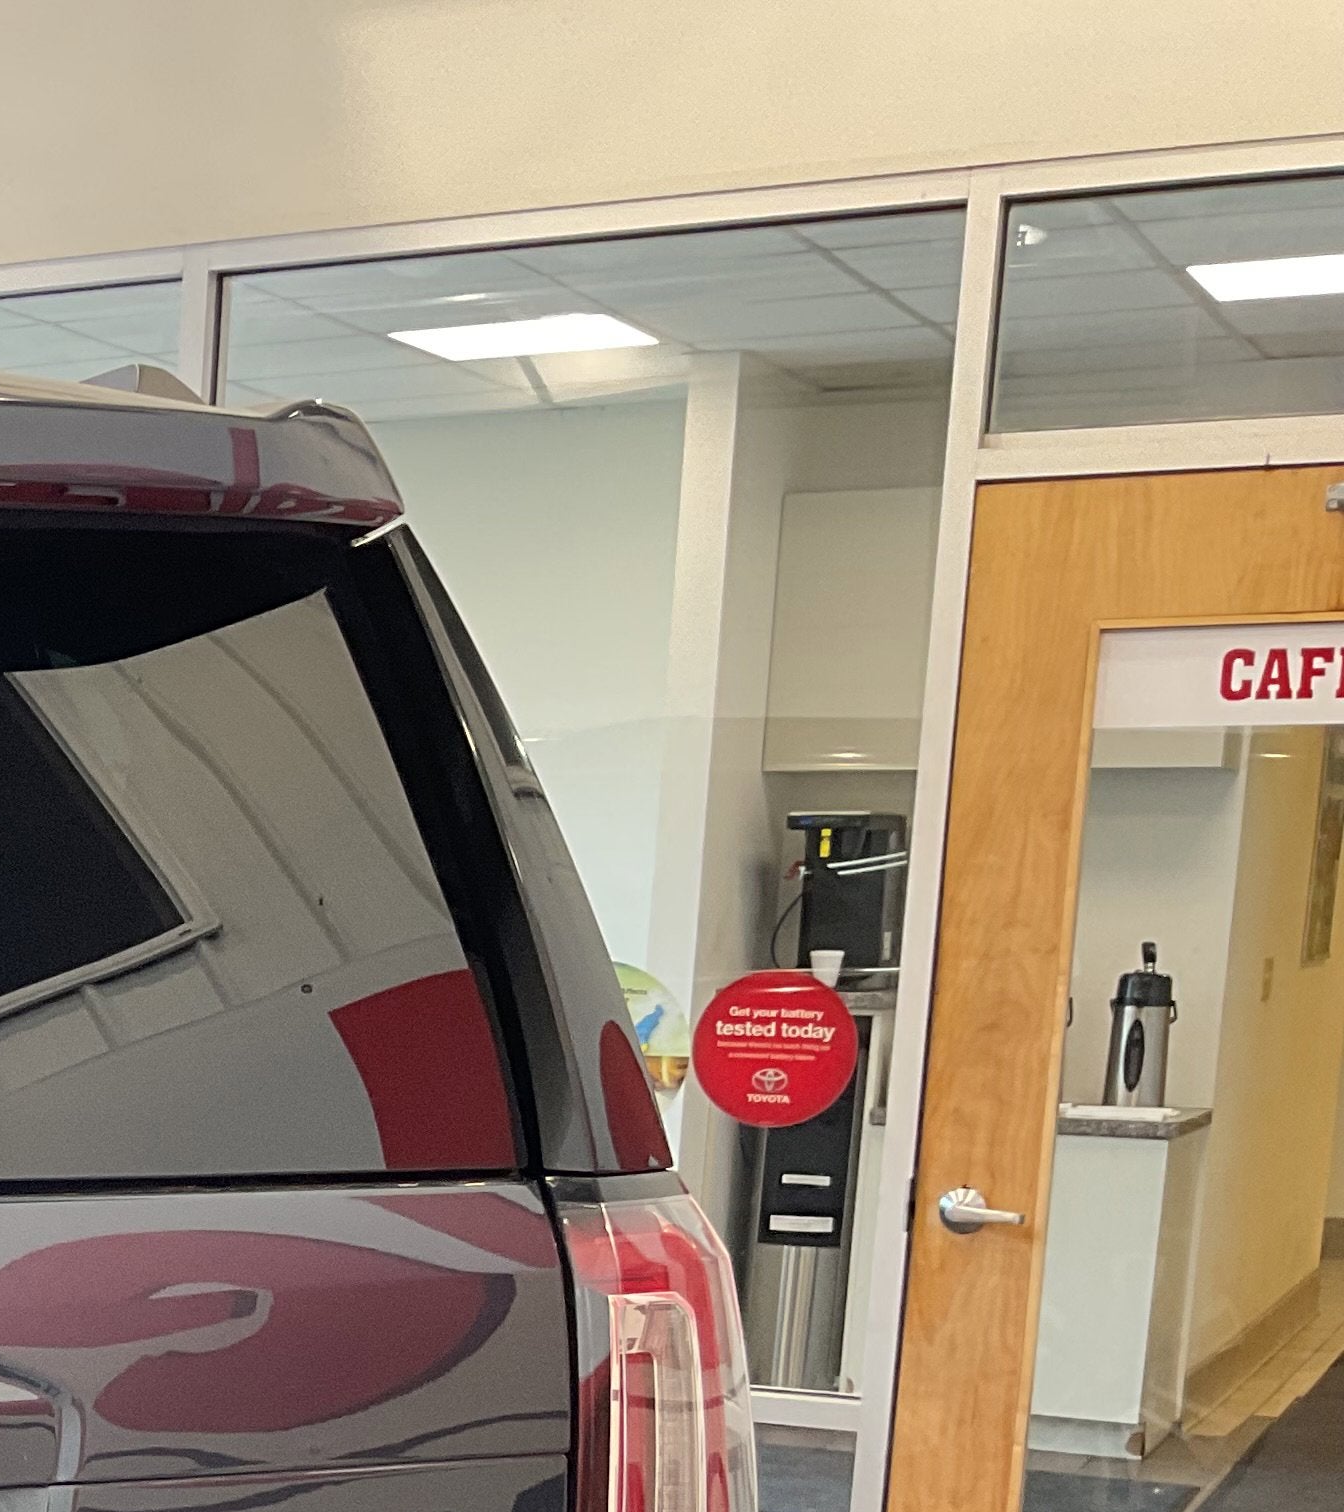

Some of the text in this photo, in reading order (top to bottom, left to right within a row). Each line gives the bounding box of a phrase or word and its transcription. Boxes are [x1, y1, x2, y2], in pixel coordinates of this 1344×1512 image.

[1219, 647, 1344, 701] CAF
[729, 1006, 824, 1021] Get your battery
[715, 1020, 836, 1042] tested today
[746, 1093, 791, 1104] TOYOTA
